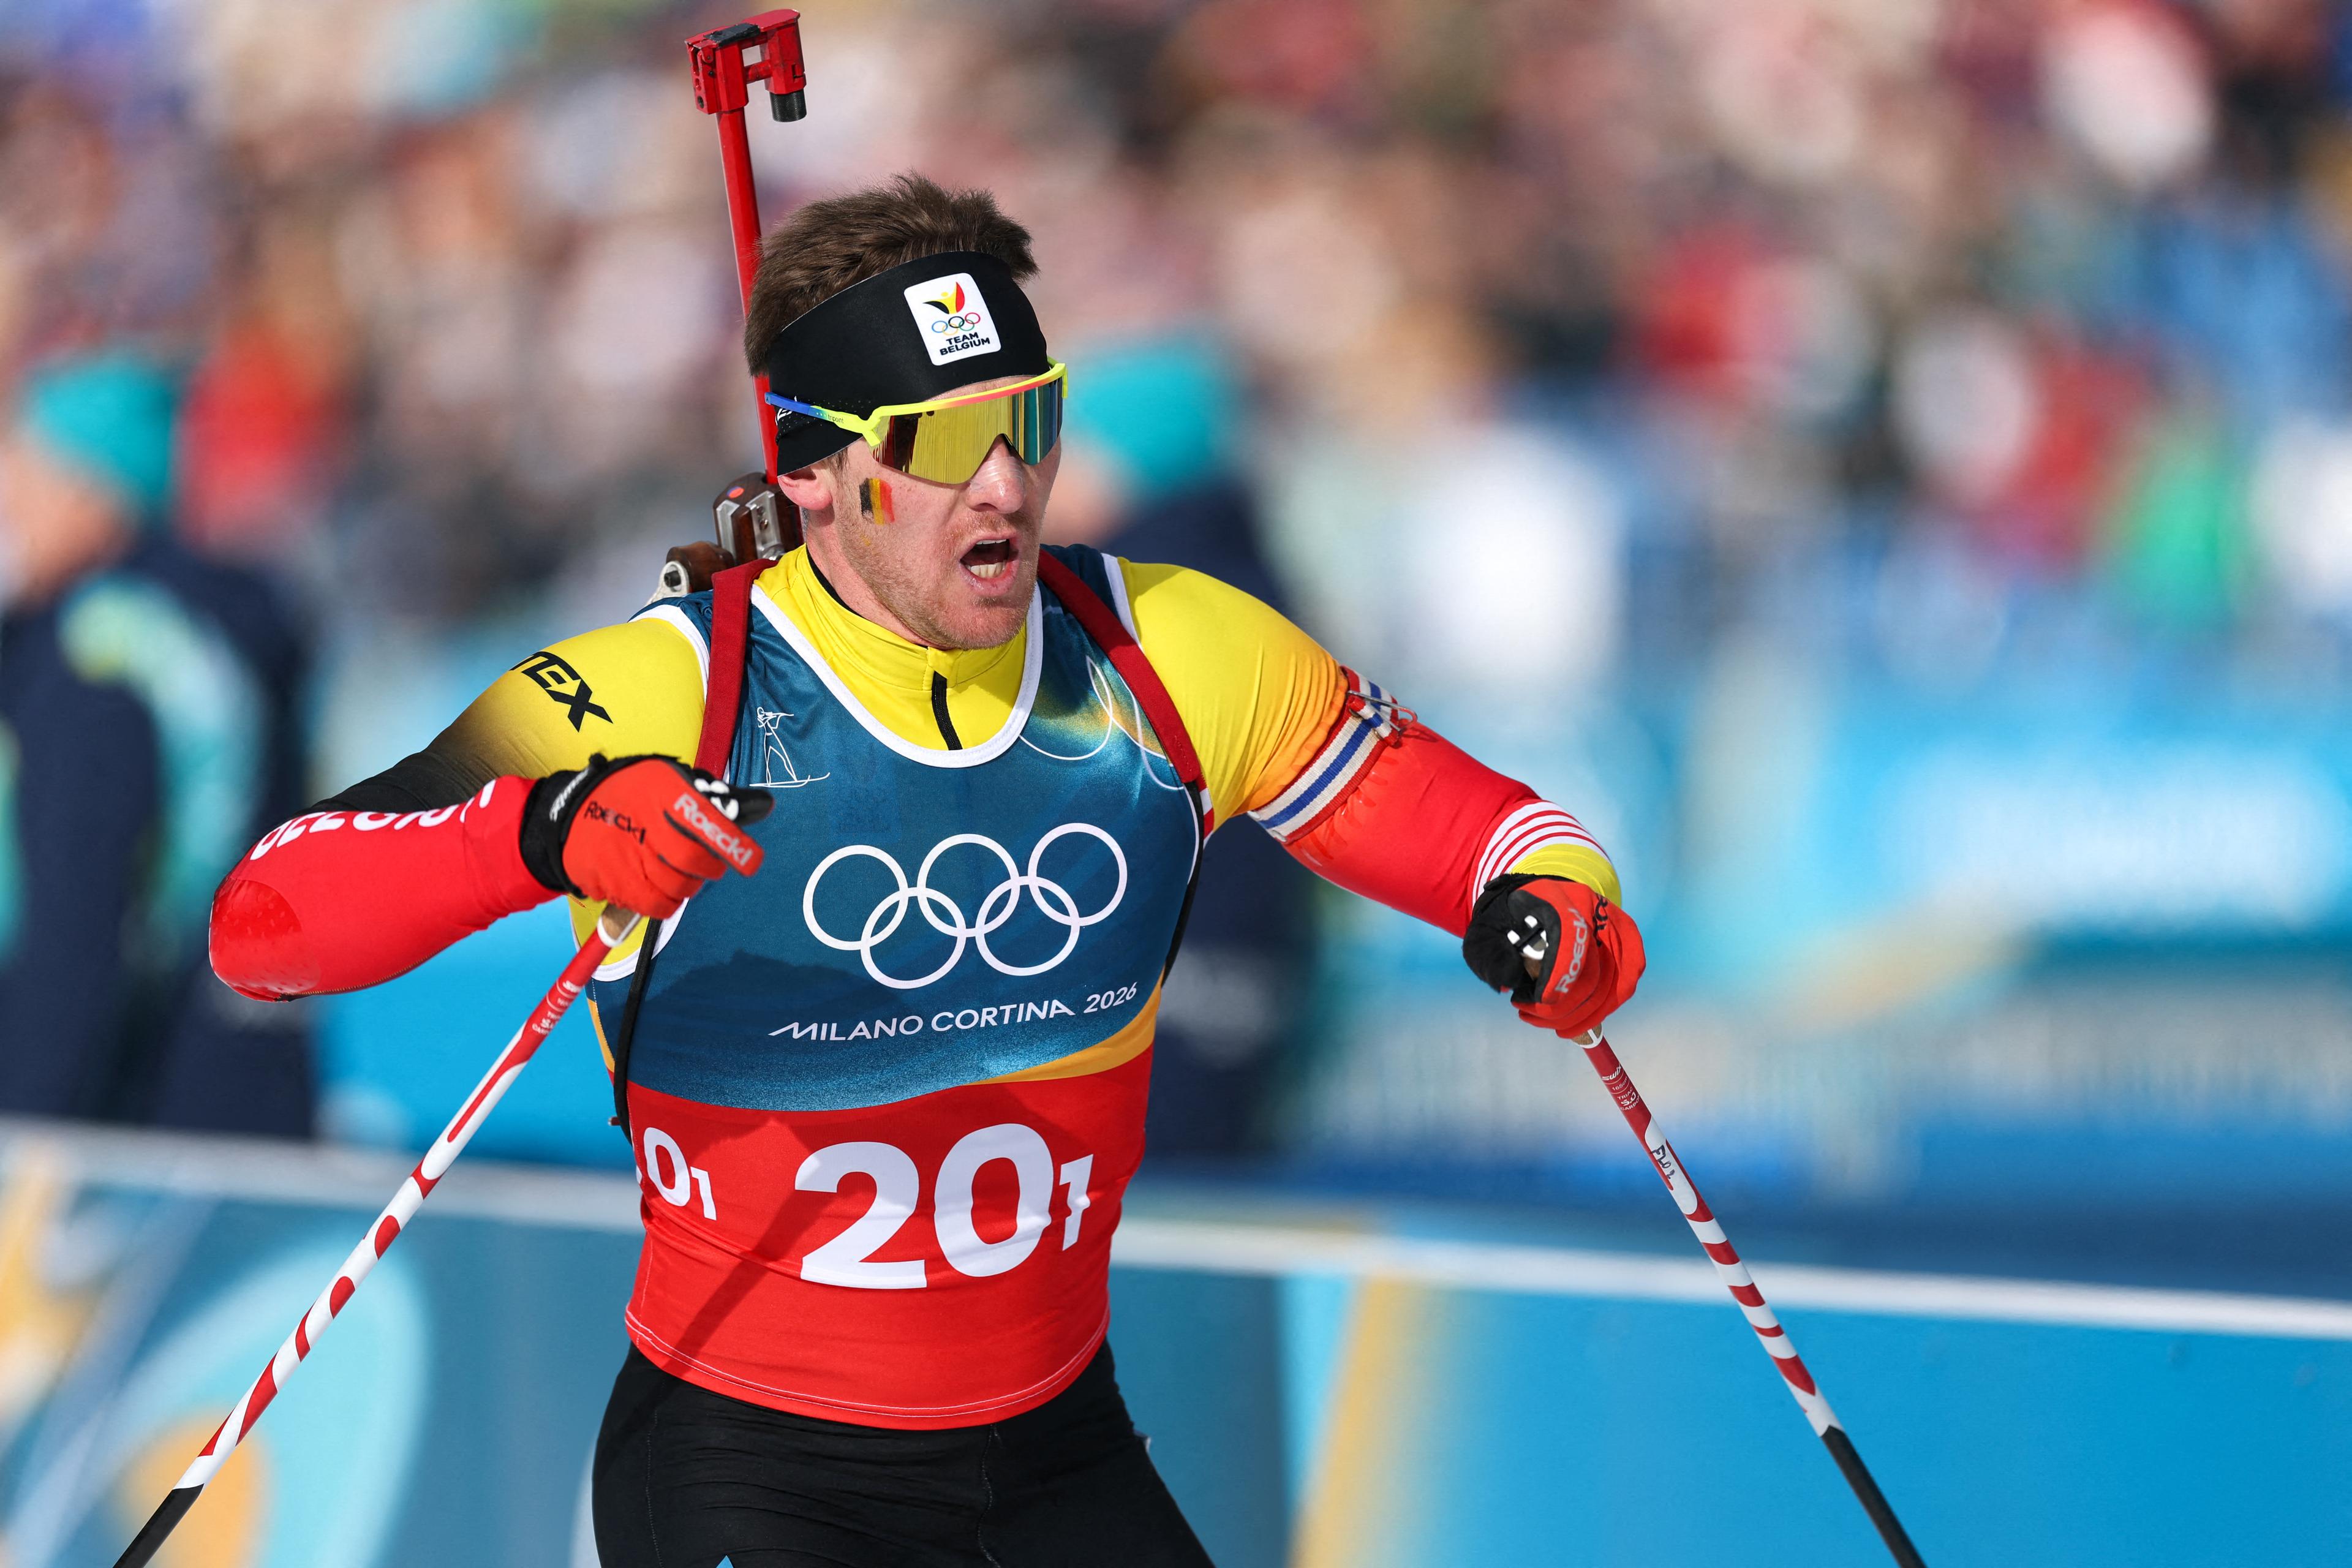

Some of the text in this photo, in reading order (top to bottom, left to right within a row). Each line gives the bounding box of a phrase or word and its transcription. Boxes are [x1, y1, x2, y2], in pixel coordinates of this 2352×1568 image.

[940, 337, 990, 356] BELGIUM
[946, 332, 979, 345] TEAM
[827, 414, 844, 424] tripoint
[767, 981, 1138, 1041] MILANO CORTINA 2026
